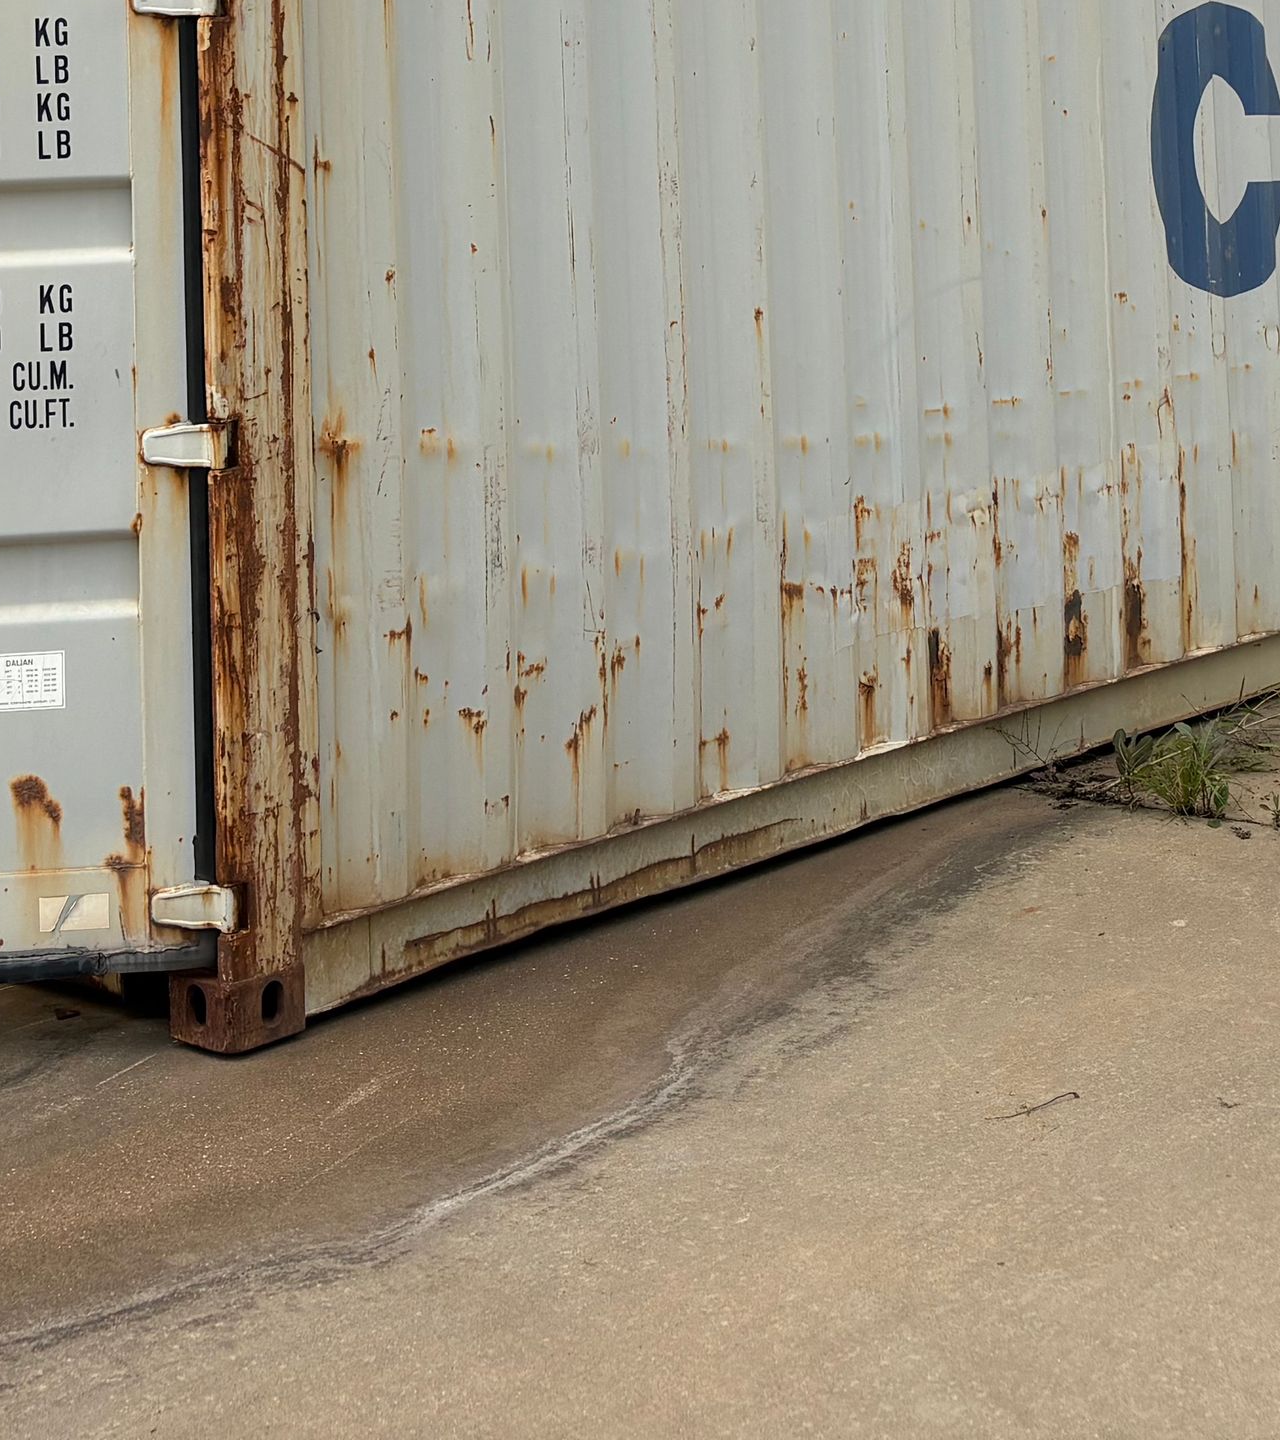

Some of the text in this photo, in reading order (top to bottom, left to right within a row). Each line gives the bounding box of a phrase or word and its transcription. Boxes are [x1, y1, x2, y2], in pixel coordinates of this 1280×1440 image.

[34, 17, 69, 47] KG
[35, 55, 70, 85] LB
[36, 92, 71, 123] KG
[37, 129, 72, 160] LB
[39, 284, 74, 314] KG
[39, 322, 74, 353] LB
[12, 359, 74, 392] CU.M.
[9, 397, 75, 430] CU.FT.
